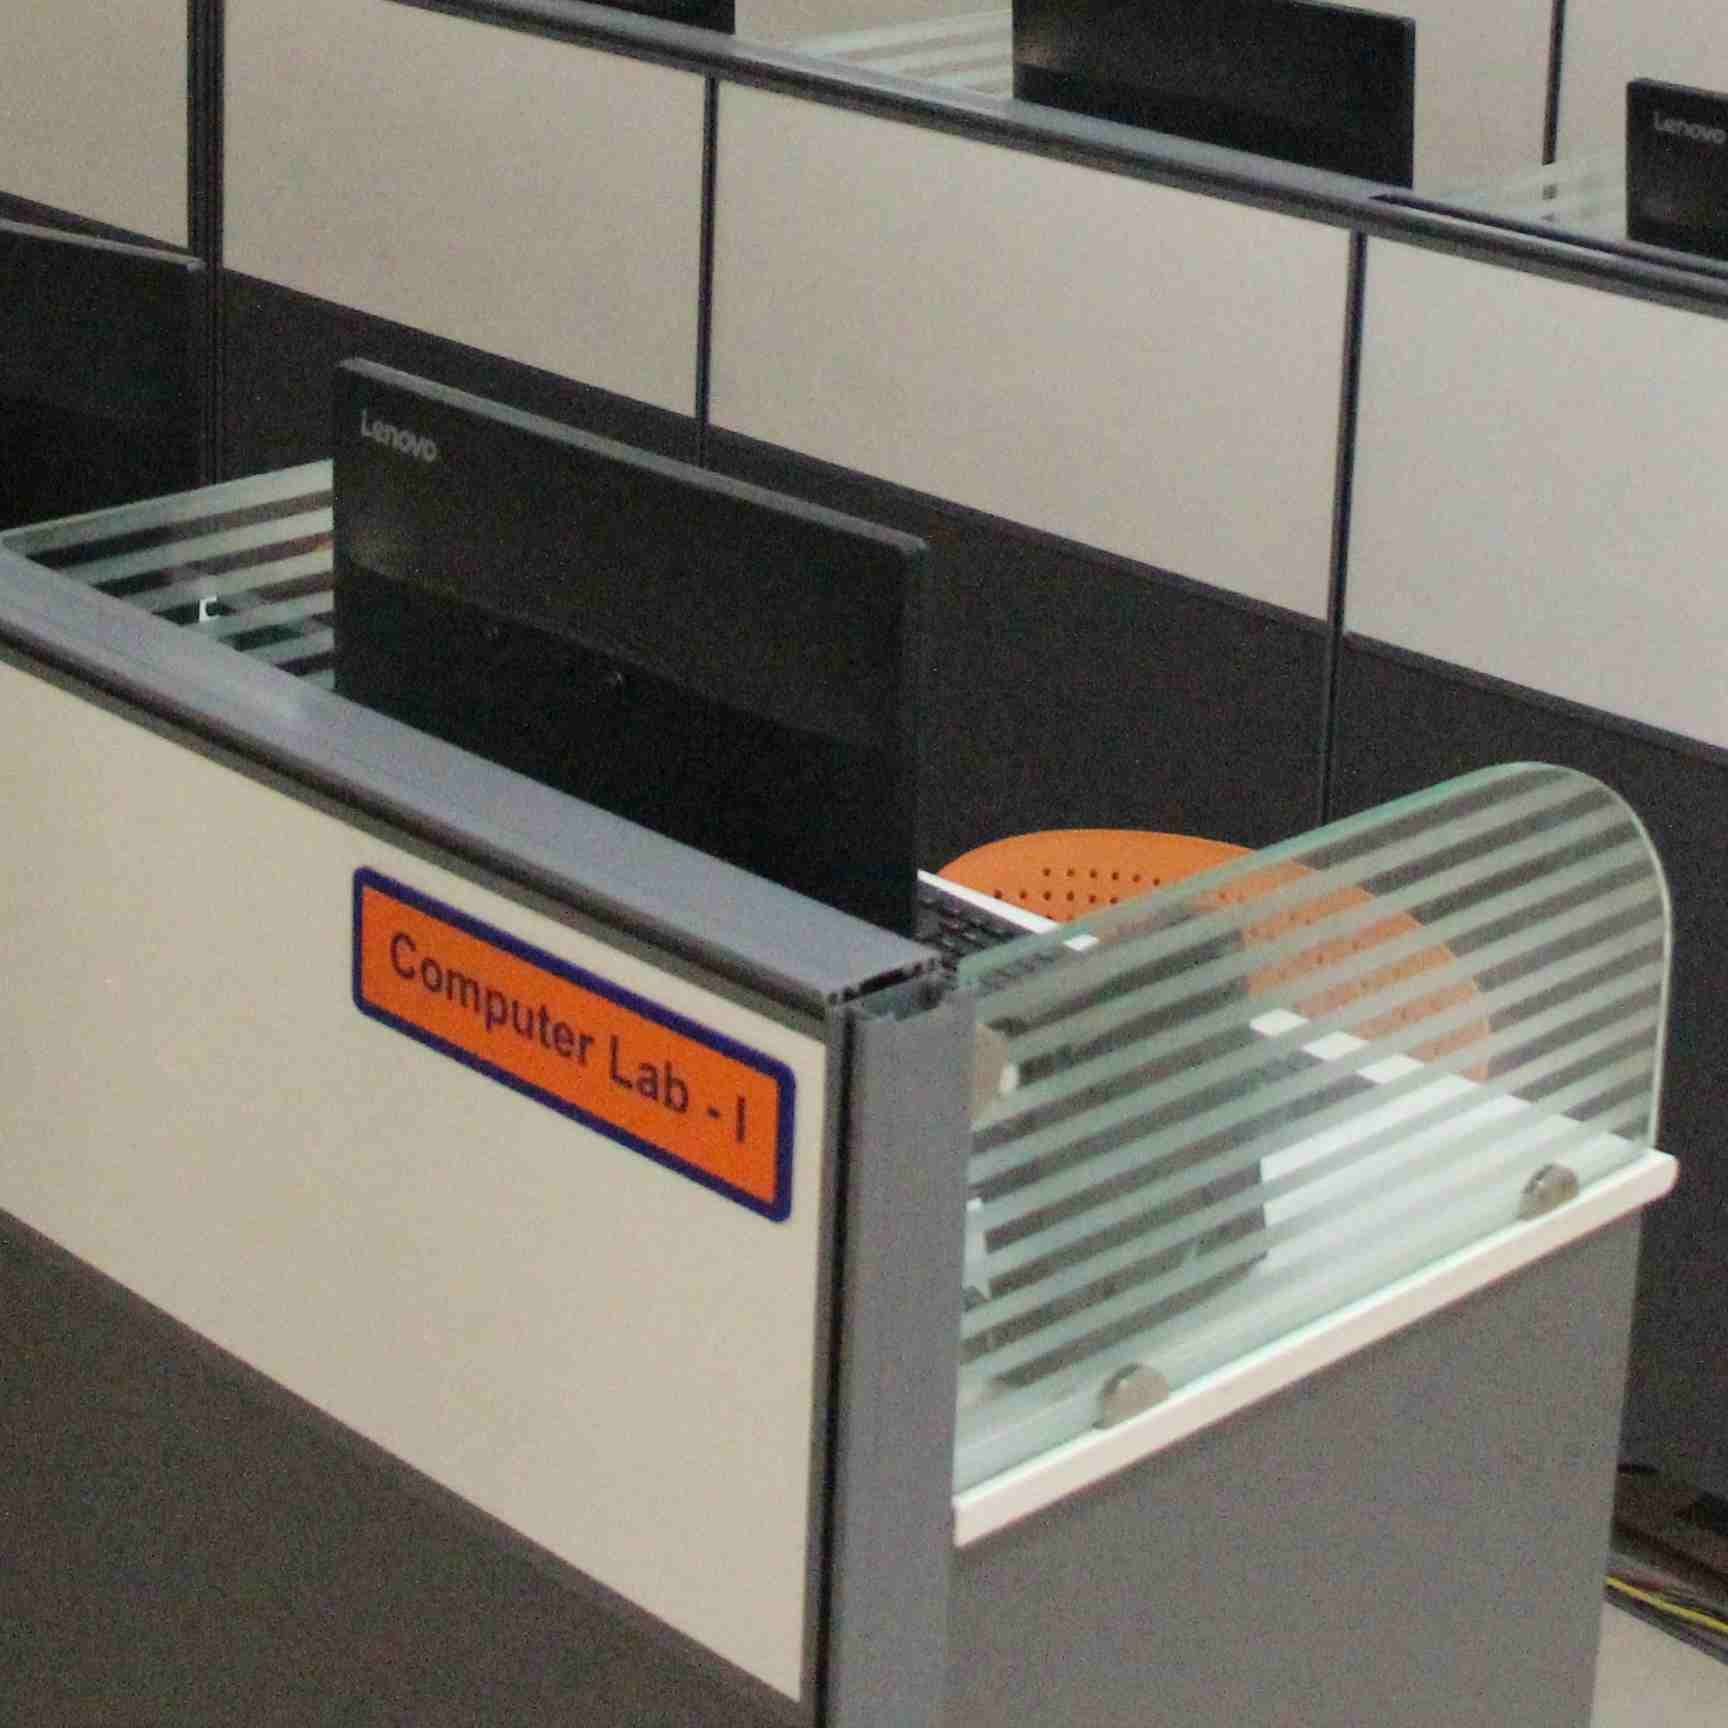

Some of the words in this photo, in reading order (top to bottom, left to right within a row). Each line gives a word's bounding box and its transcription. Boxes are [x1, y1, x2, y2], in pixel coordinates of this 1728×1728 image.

[1652, 110, 1728, 145] Lenovo
[360, 408, 438, 463] Lenovo
[390, 931, 595, 1067] Computer
[608, 1033, 690, 1116] Lab
[735, 1095, 747, 1145] I
